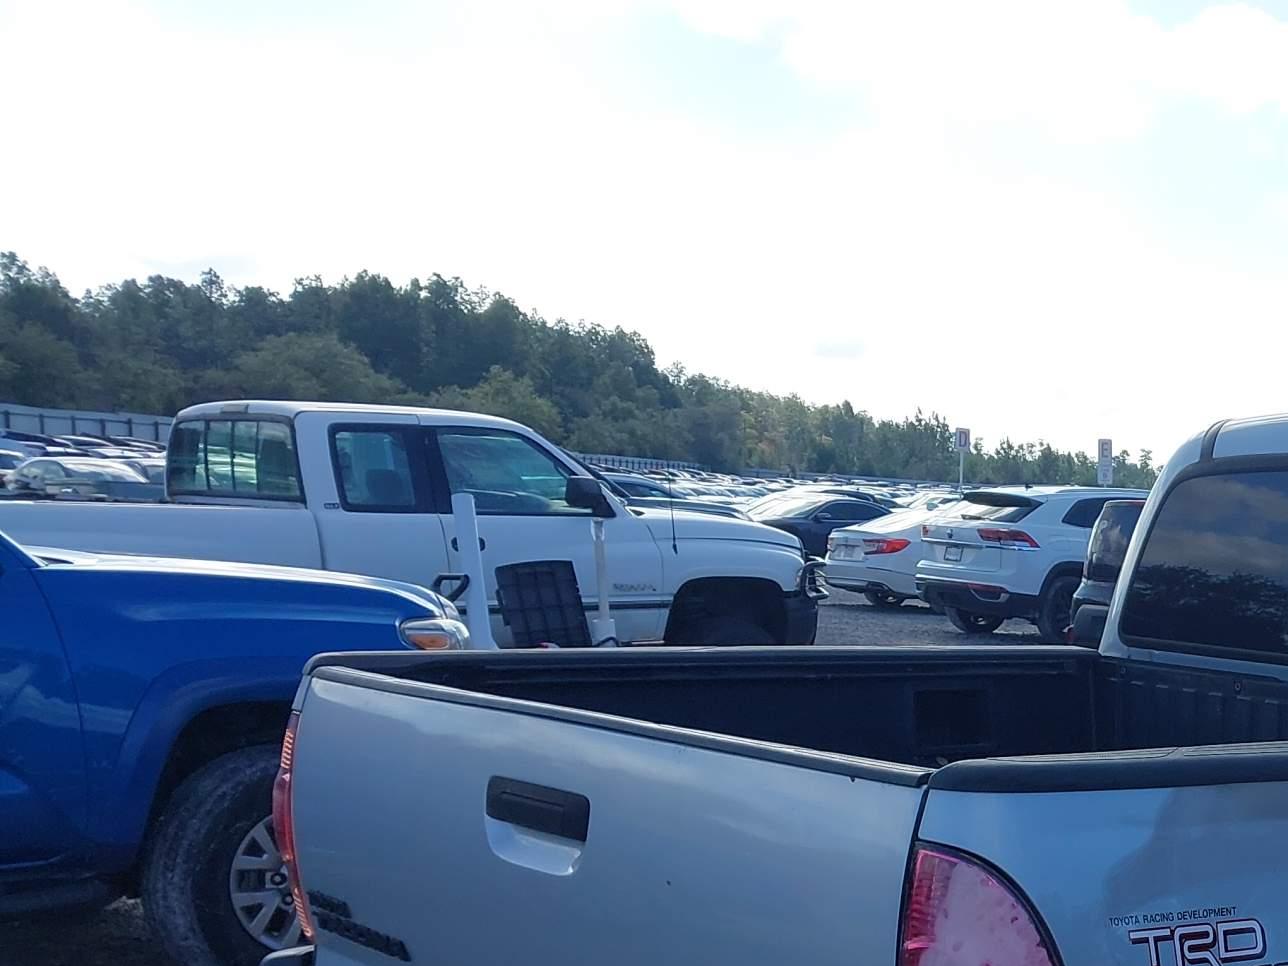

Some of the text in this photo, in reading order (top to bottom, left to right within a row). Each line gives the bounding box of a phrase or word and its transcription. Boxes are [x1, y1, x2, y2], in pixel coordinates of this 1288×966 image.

[959, 430, 968, 448] D
[1101, 441, 1109, 458] E
[1109, 906, 1237, 927] TOYOTA RACING DEVELOPMENT
